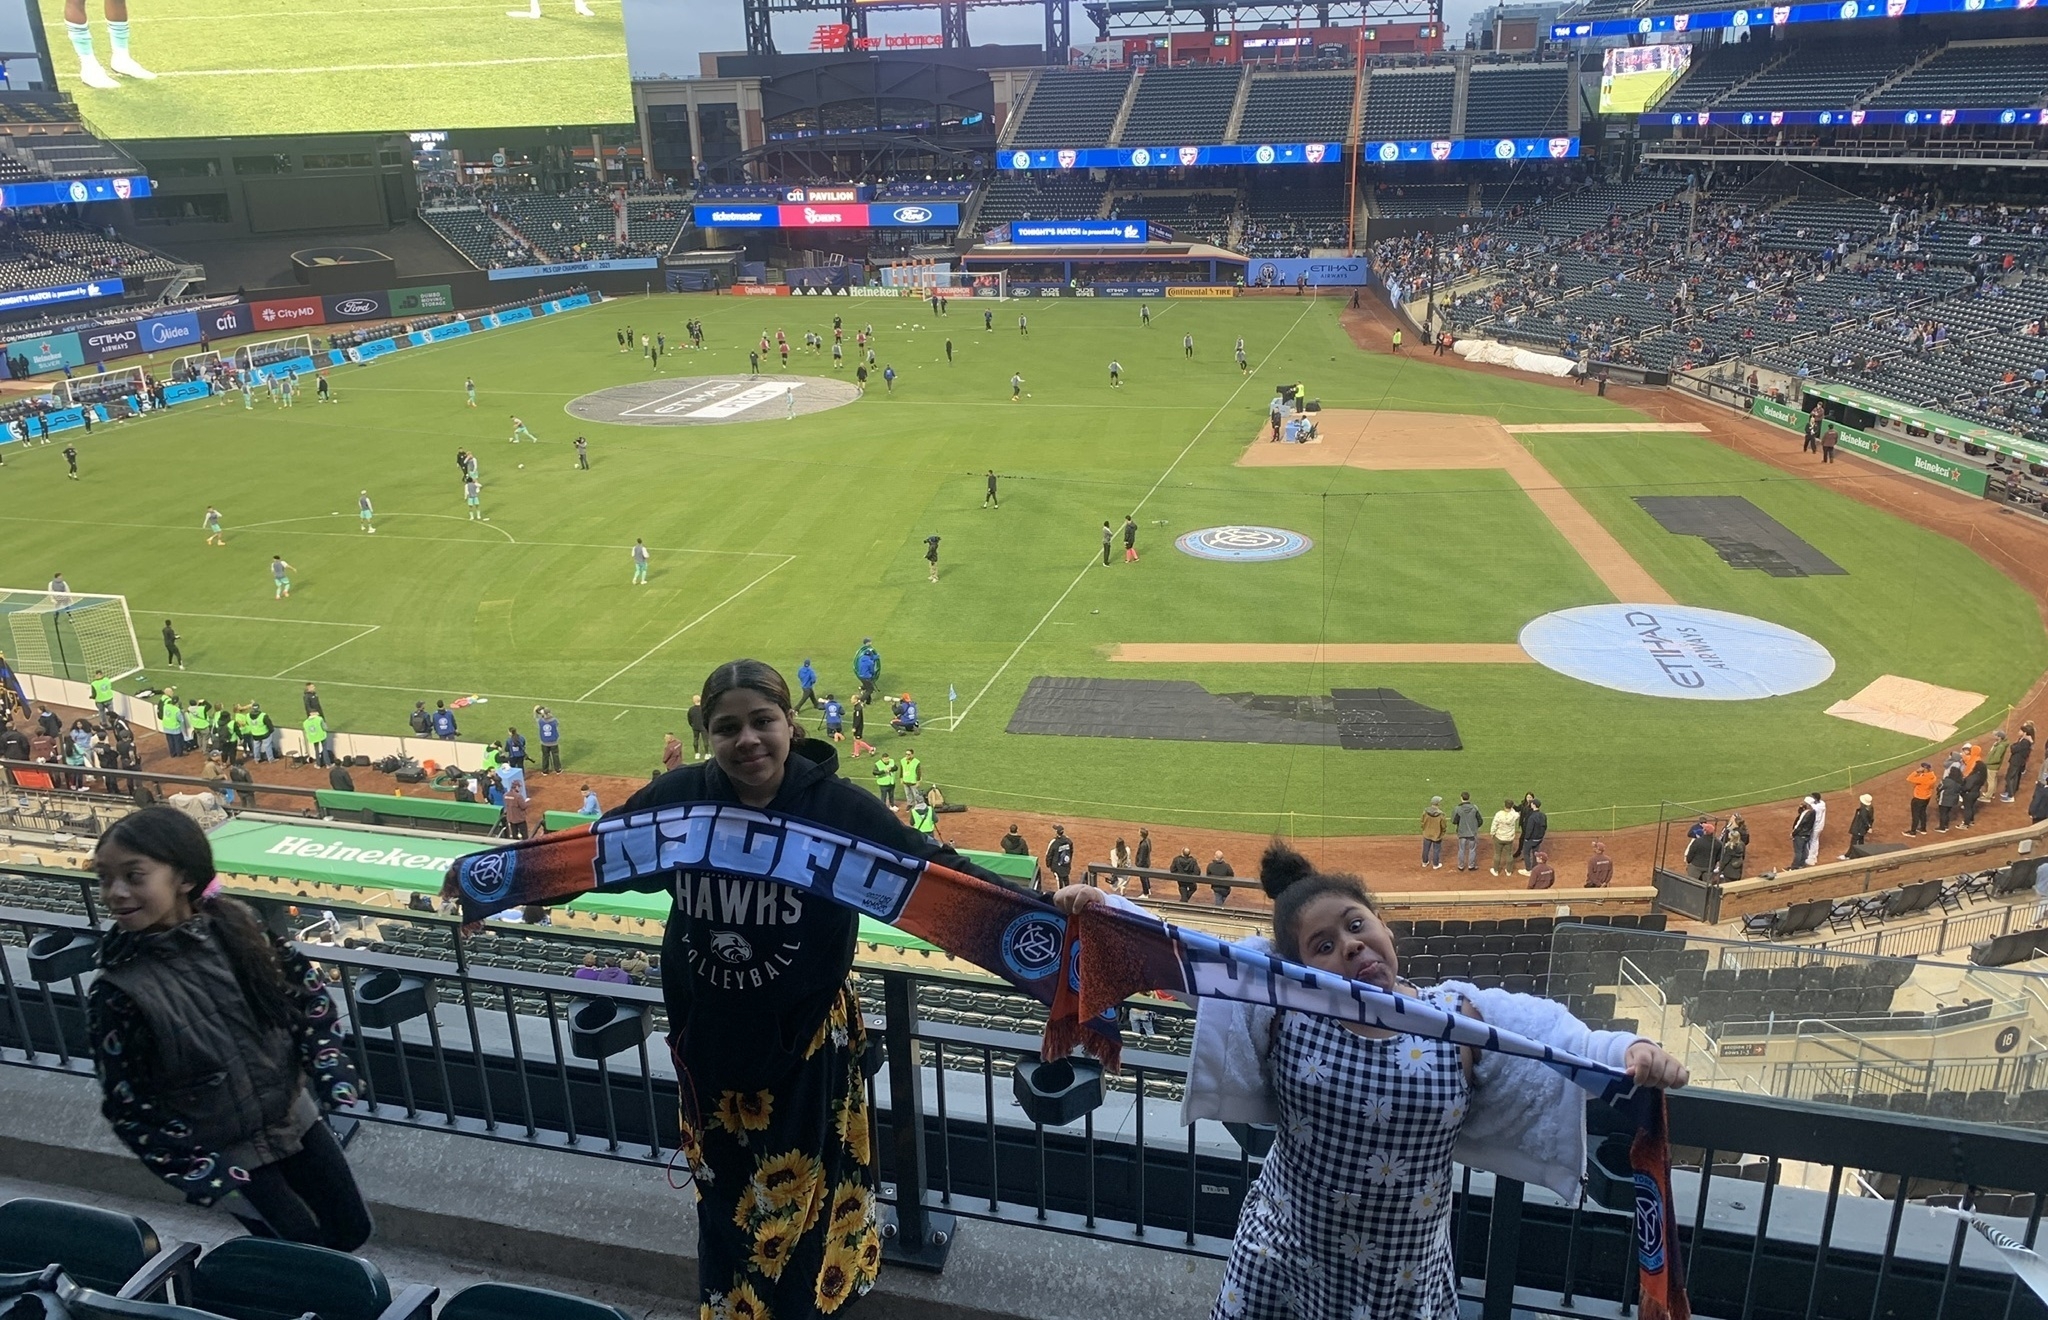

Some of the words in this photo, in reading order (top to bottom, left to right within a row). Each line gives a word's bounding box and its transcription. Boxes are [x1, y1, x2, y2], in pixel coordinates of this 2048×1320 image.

[853, 37, 882, 48] new
[885, 33, 943, 47] balance
[787, 189, 804, 202] citi
[809, 191, 854, 201] PAVILION
[712, 211, 762, 222] ticketmaster
[901, 210, 924, 221] Ford
[1018, 228, 1056, 236] TONIGHT'S
[1088, 228, 1114, 236] presented
[562, 264, 588, 272] CHAMPIONS
[850, 286, 899, 297] Heineken
[1168, 287, 1207, 297] Continental
[344, 302, 371, 313] Ford
[422, 300, 446, 308] STORAGE
[277, 306, 314, 319] CityMD
[216, 311, 237, 331] citi
[88, 330, 136, 347] ETIHAD
[156, 324, 190, 342] Midea
[101, 342, 128, 353] AIRWAYS
[33, 351, 62, 363] Heineken
[38, 359, 60, 369] SILVER
[654, 382, 742, 414] ETIHAD
[1764, 404, 1790, 422] Heineken
[1840, 431, 1870, 450] Heineken
[1914, 456, 1951, 478] Heineken
[1625, 611, 1705, 689] ETIHAD
[1676, 627, 1730, 670] AIRWAYS
[265, 836, 454, 872] Heineken
[597, 805, 920, 918] NYCFC
[676, 870, 803, 925] HAWKS
[1005, 921, 1019, 942] YORK
[1018, 913, 1035, 923] CITY
[2002, 1033, 2014, 1046] 18
